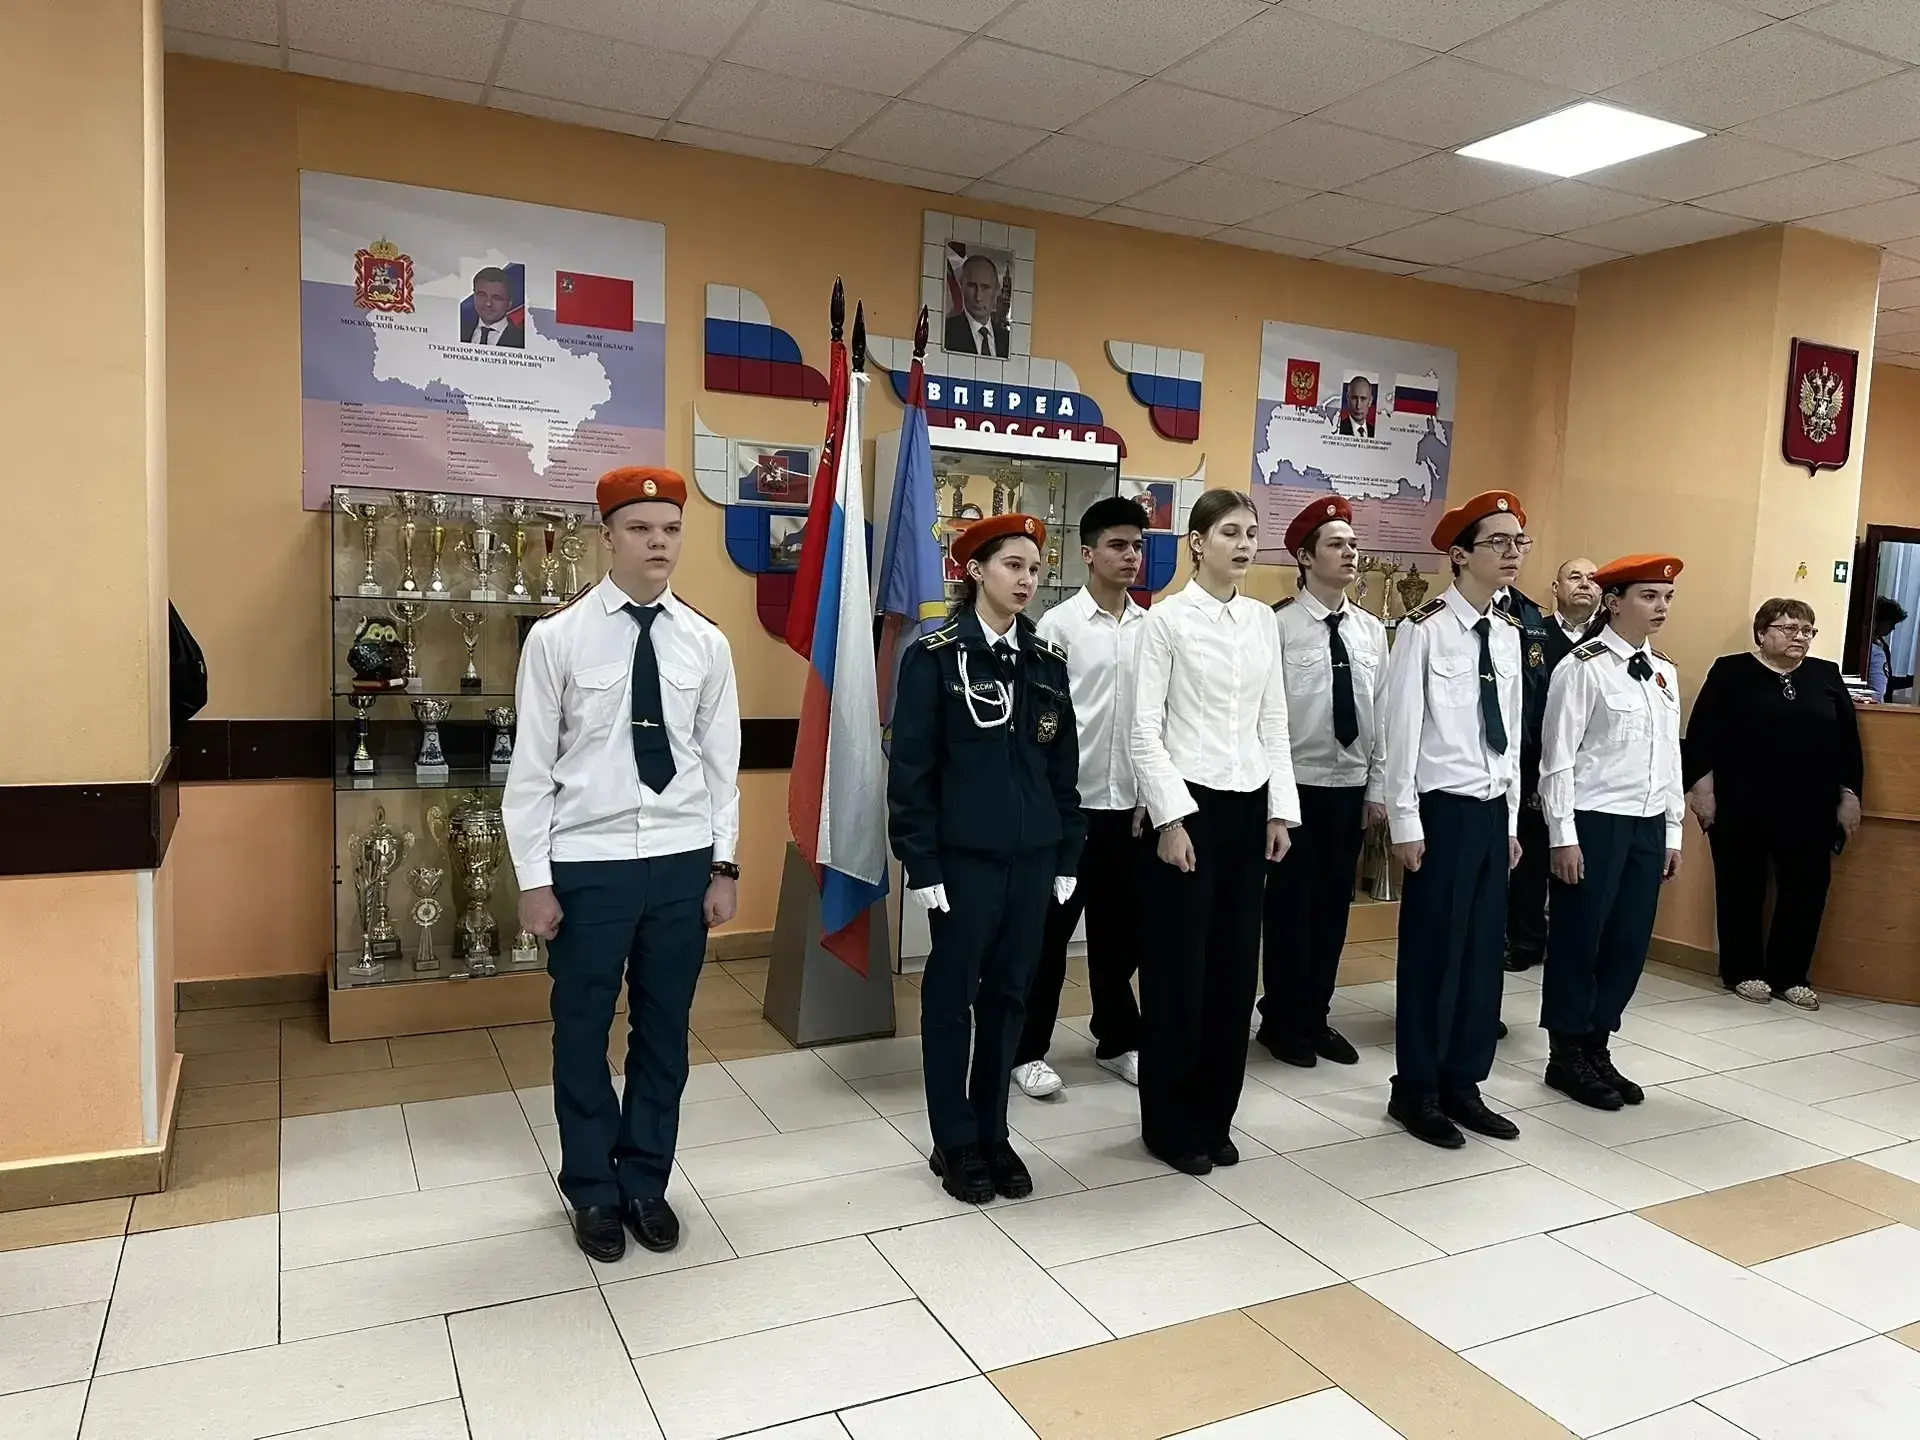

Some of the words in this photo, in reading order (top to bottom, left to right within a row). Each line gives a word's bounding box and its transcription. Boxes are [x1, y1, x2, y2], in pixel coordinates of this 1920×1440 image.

[375, 314, 394, 322] ГЕРБ
[340, 318, 393, 330] МОСКОВСКОЙ
[394, 324, 428, 333] ОБЛАСТИ
[474, 348, 522, 359] МОСКОВСКОЙ
[927, 381, 1074, 417] ВПЕРЕД
[953, 416, 1097, 444] РОССИЯ
[969, 682, 994, 692] ОССИИ
